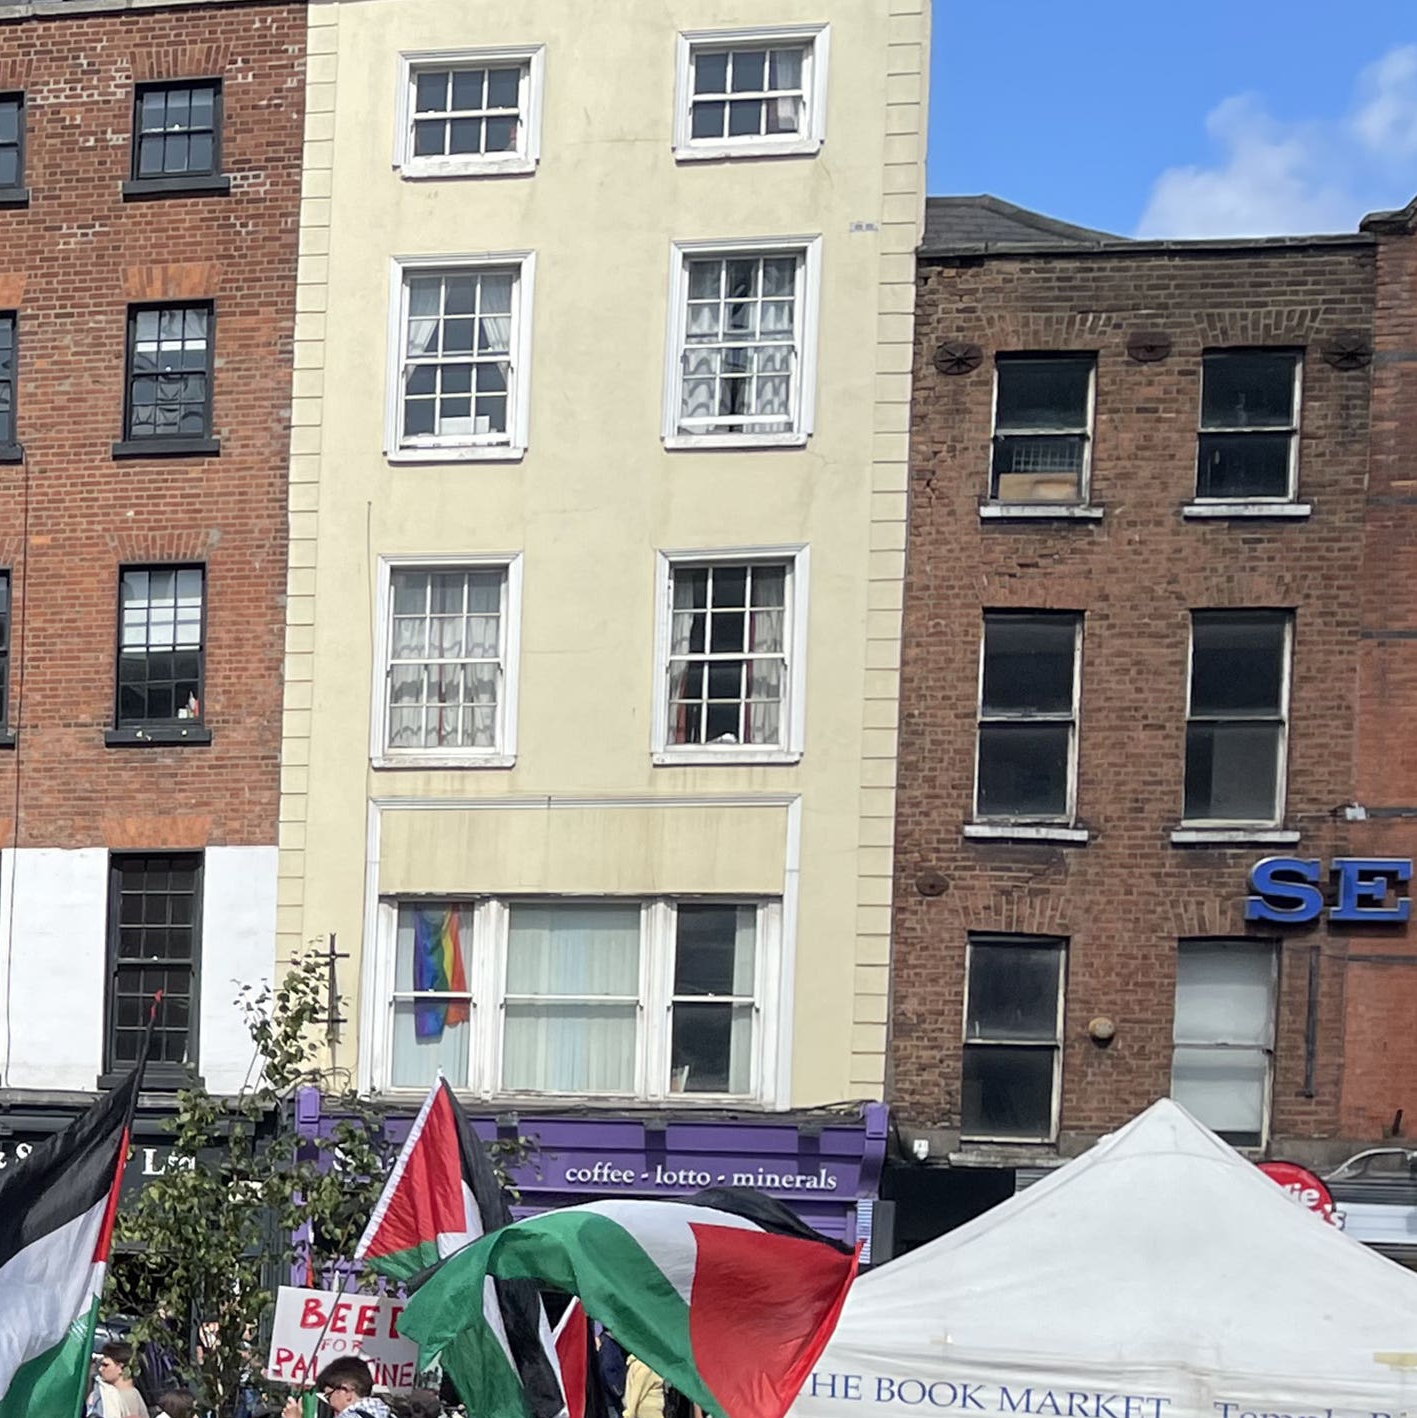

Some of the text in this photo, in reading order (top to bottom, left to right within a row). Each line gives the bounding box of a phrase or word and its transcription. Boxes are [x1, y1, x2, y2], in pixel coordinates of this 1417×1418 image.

[565, 1161, 635, 1184] coffee
[655, 1164, 712, 1186] lotto
[732, 1168, 838, 1190] minerals
[321, 1338, 364, 1352] FOR
[808, 1372, 863, 1400] HE
[874, 1376, 986, 1410] BOOK
